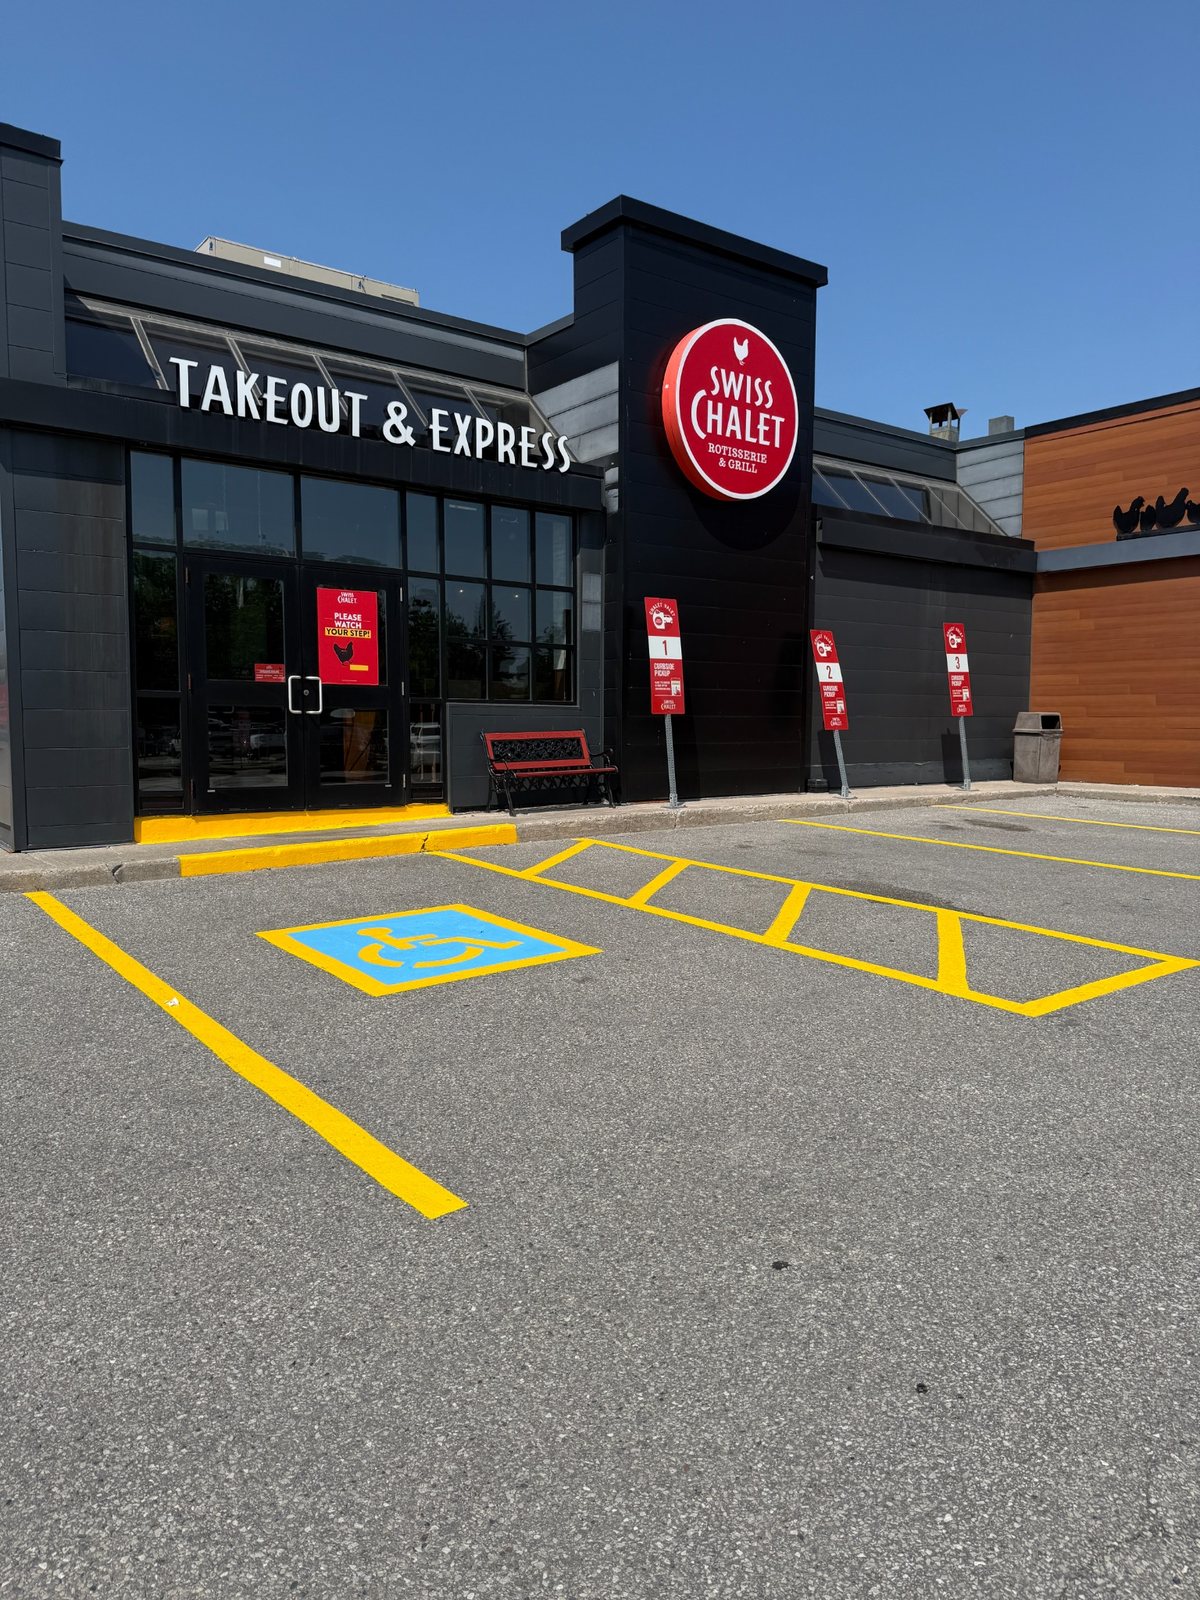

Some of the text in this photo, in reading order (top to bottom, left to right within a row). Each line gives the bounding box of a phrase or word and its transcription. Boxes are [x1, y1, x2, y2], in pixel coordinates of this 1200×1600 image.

[710, 365, 774, 409] SWISS
[168, 356, 571, 473] TAKEOUT & EXPRESS
[691, 389, 785, 449] CHALET
[708, 442, 768, 464] ROTISSERIE
[718, 457, 758, 474] & GRILL
[334, 612, 362, 622] PLEASE
[664, 603, 676, 617] VALET
[334, 620, 362, 629] WATCH
[326, 628, 370, 638] YOUR STEP!
[662, 639, 668, 656] 1
[955, 656, 961, 670] 3
[654, 669, 671, 677] PICKUP
[826, 665, 833, 679] 2
